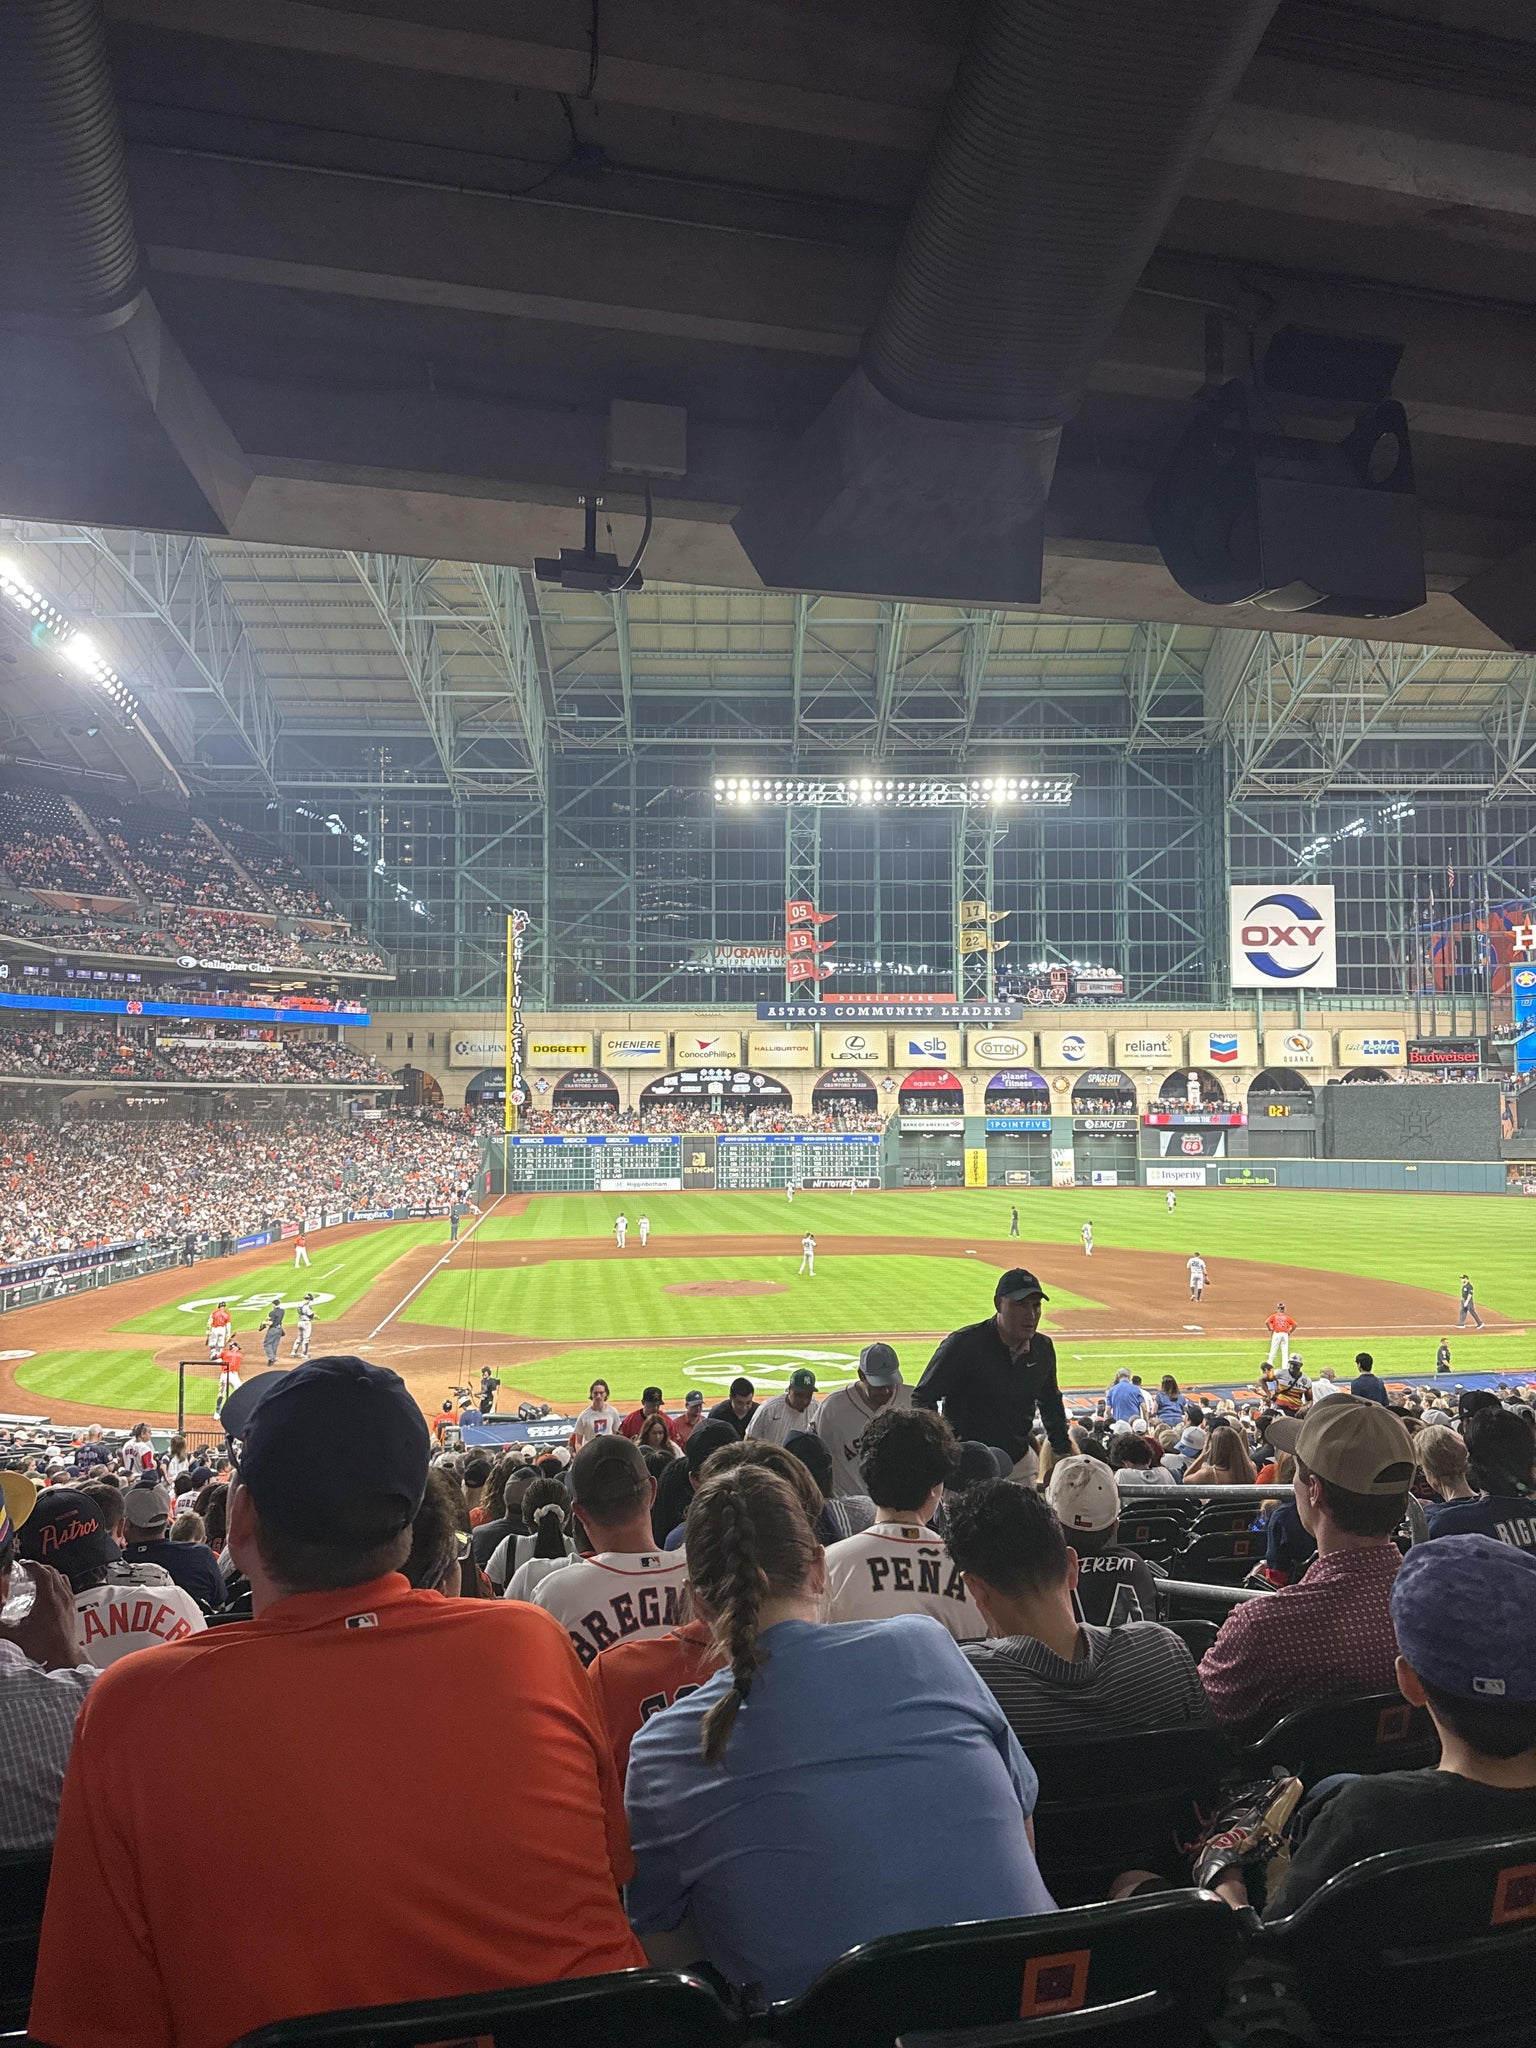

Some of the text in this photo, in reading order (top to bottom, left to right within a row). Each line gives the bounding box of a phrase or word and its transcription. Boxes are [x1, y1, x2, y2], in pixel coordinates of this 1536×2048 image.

[792, 906, 806, 918] 05
[966, 906, 980, 917] 17
[793, 936, 807, 947] 19
[966, 936, 980, 946] 22
[1242, 926, 1325, 946] OXY
[733, 948, 788, 958] CRAWFOR
[200, 958, 273, 973] Gallagher Club
[792, 964, 806, 974] 21
[768, 1006, 1012, 1016] ASTROS COMMUNITY LEADERS
[470, 1044, 506, 1052] CALPIN
[608, 1040, 661, 1049] CHENIERE
[924, 1037, 946, 1051] slb
[981, 1042, 1020, 1056] COTTON
[1126, 1039, 1168, 1052] reliant
[1363, 1040, 1400, 1054] LNG
[679, 1050, 736, 1059] ConocoPhillips
[1409, 1051, 1478, 1063] Budweiser
[511, 1037, 522, 1089] FAIR
[1001, 1072, 1028, 1082] planet
[1088, 1073, 1122, 1083] SPACE CITY
[914, 1080, 936, 1088] equinor
[990, 1120, 1048, 1129] 1POINTFIVE
[1185, 1142, 1198, 1150] 66
[1162, 1170, 1202, 1180] Insperity
[812, 1180, 870, 1188] NITTOTIREOM
[352, 1210, 391, 1221] AmegyBank
[55, 1508, 79, 1521] HOUSTON
[39, 1517, 99, 1556] Astros
[866, 1547, 967, 1603] PEÑA
[78, 1601, 192, 1647] ANDER
